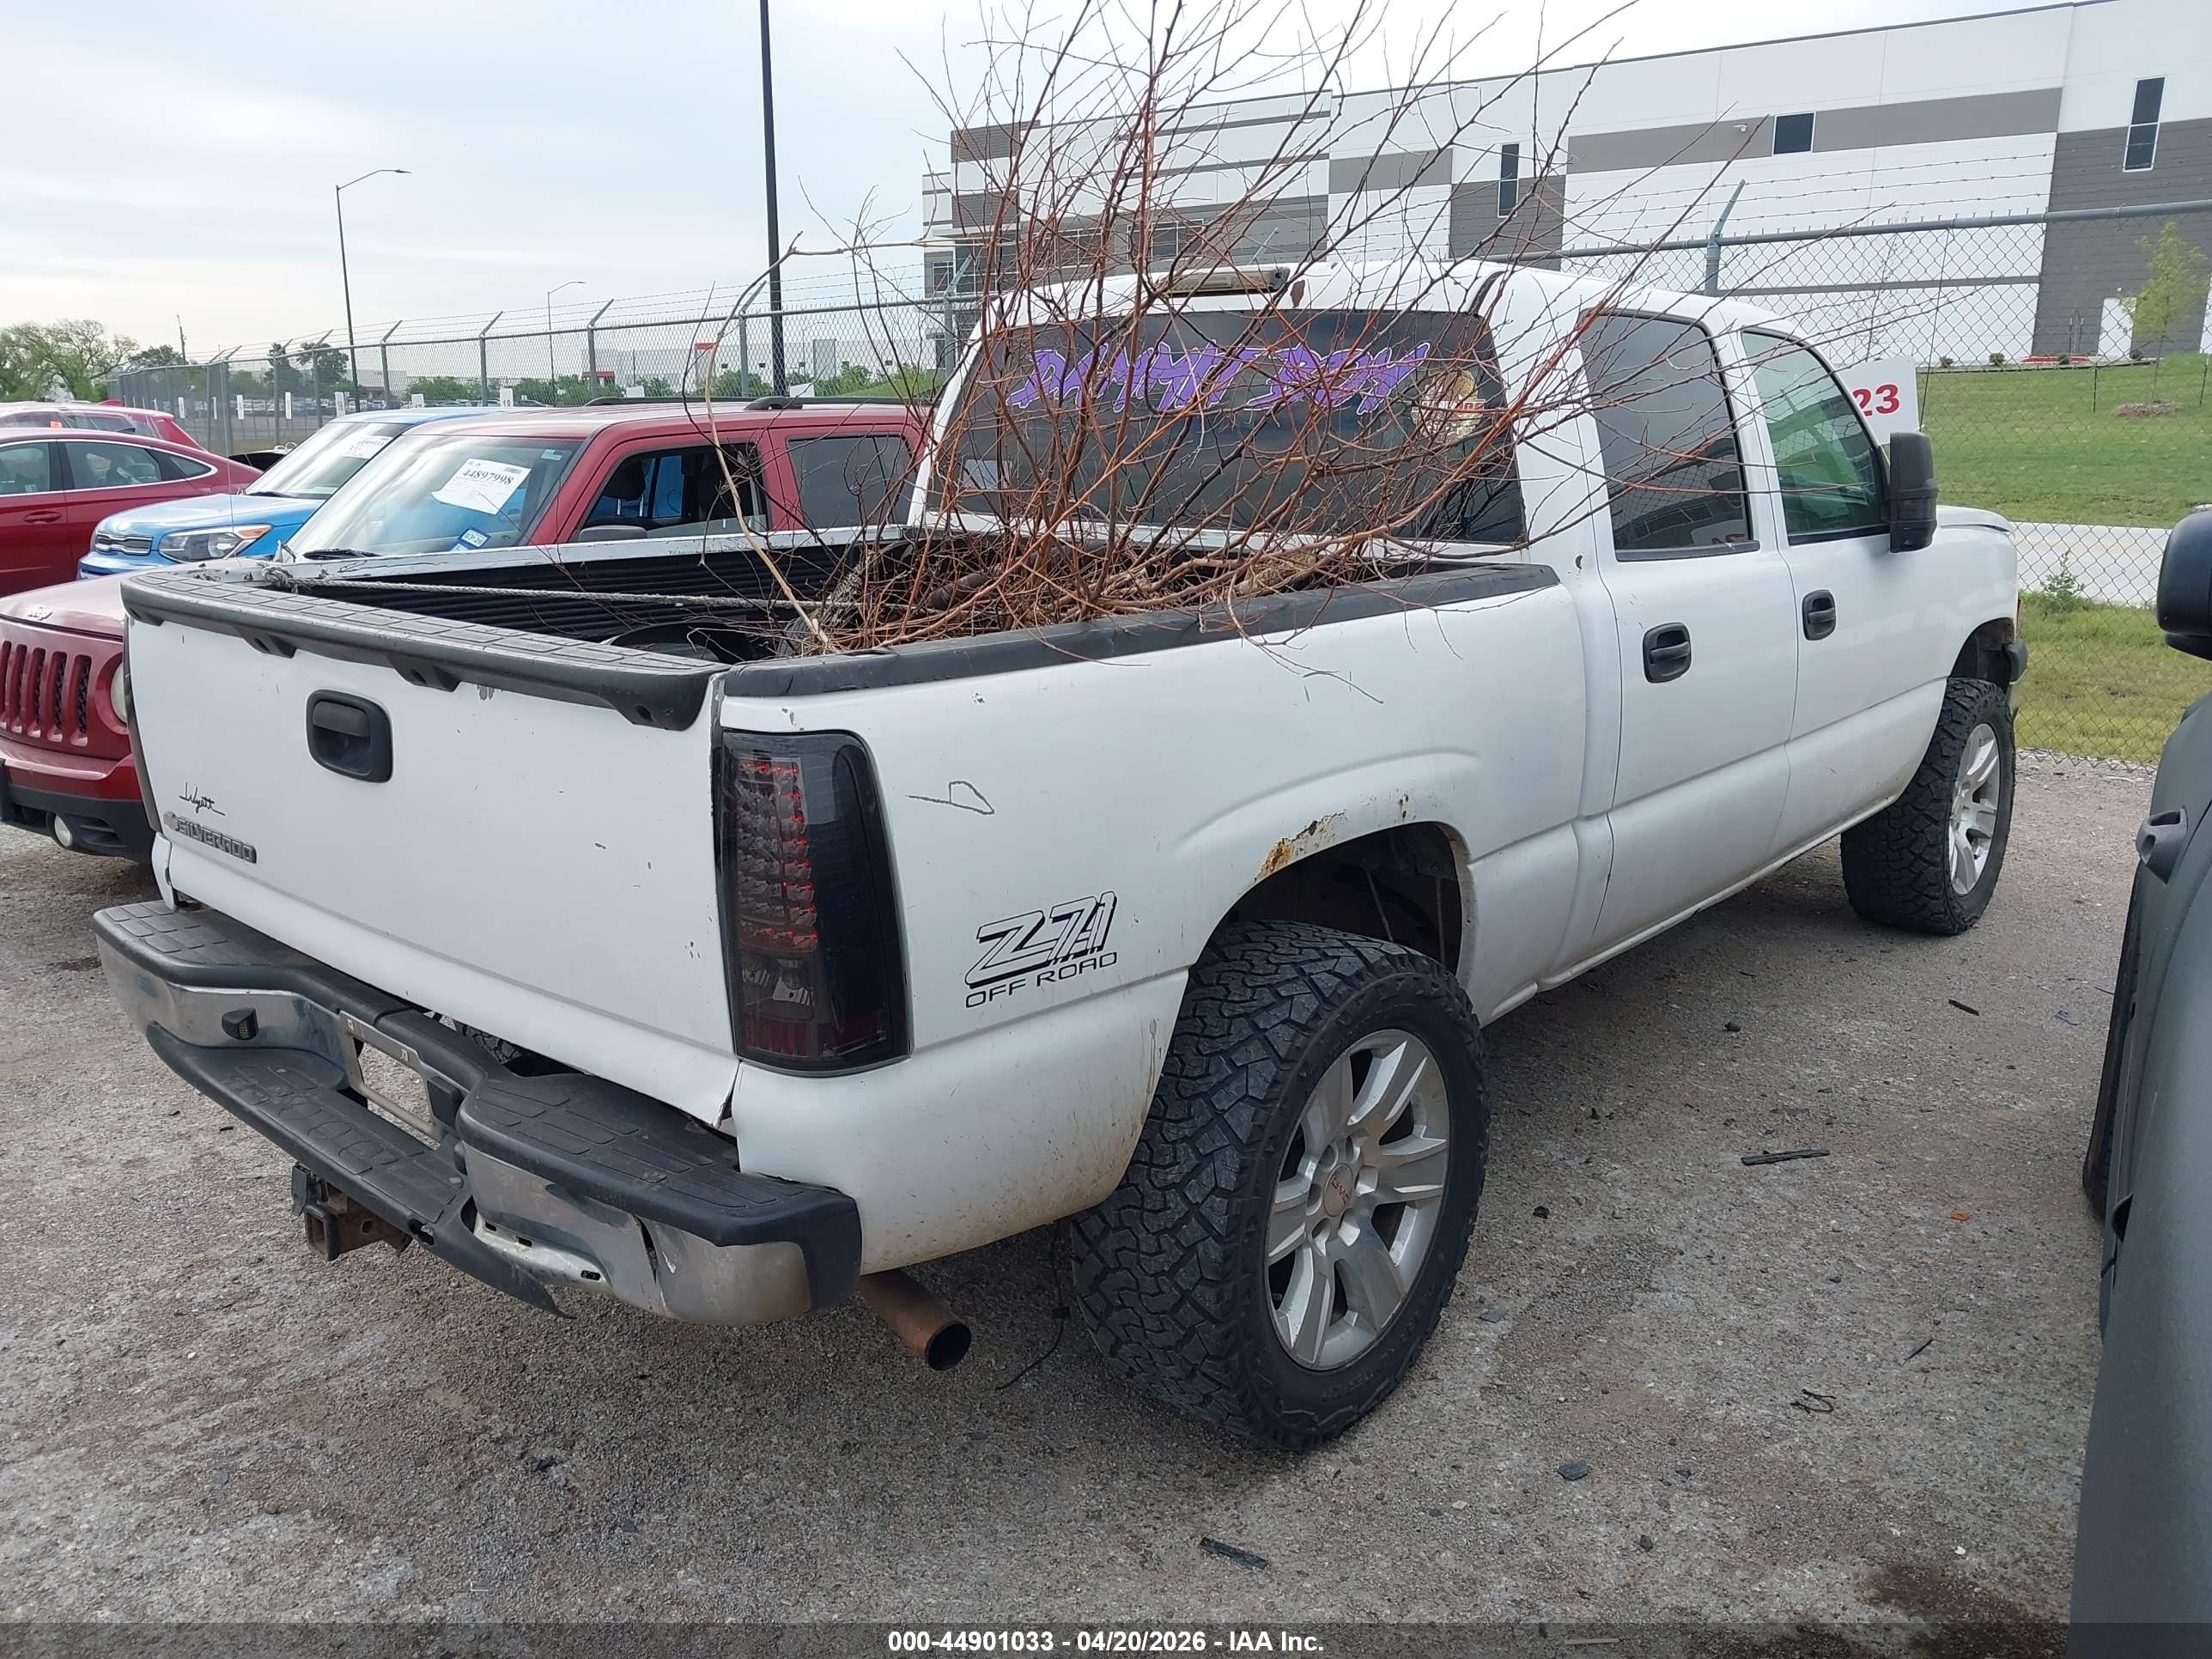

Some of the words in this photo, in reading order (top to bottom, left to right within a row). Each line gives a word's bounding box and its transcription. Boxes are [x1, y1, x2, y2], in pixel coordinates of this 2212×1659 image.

[462, 469, 514, 485] 44897998
[178, 817, 254, 863] SILVERADO
[964, 890, 1117, 988] Z71
[965, 979, 1026, 1008] OFF
[1036, 951, 1117, 987] ROAD
